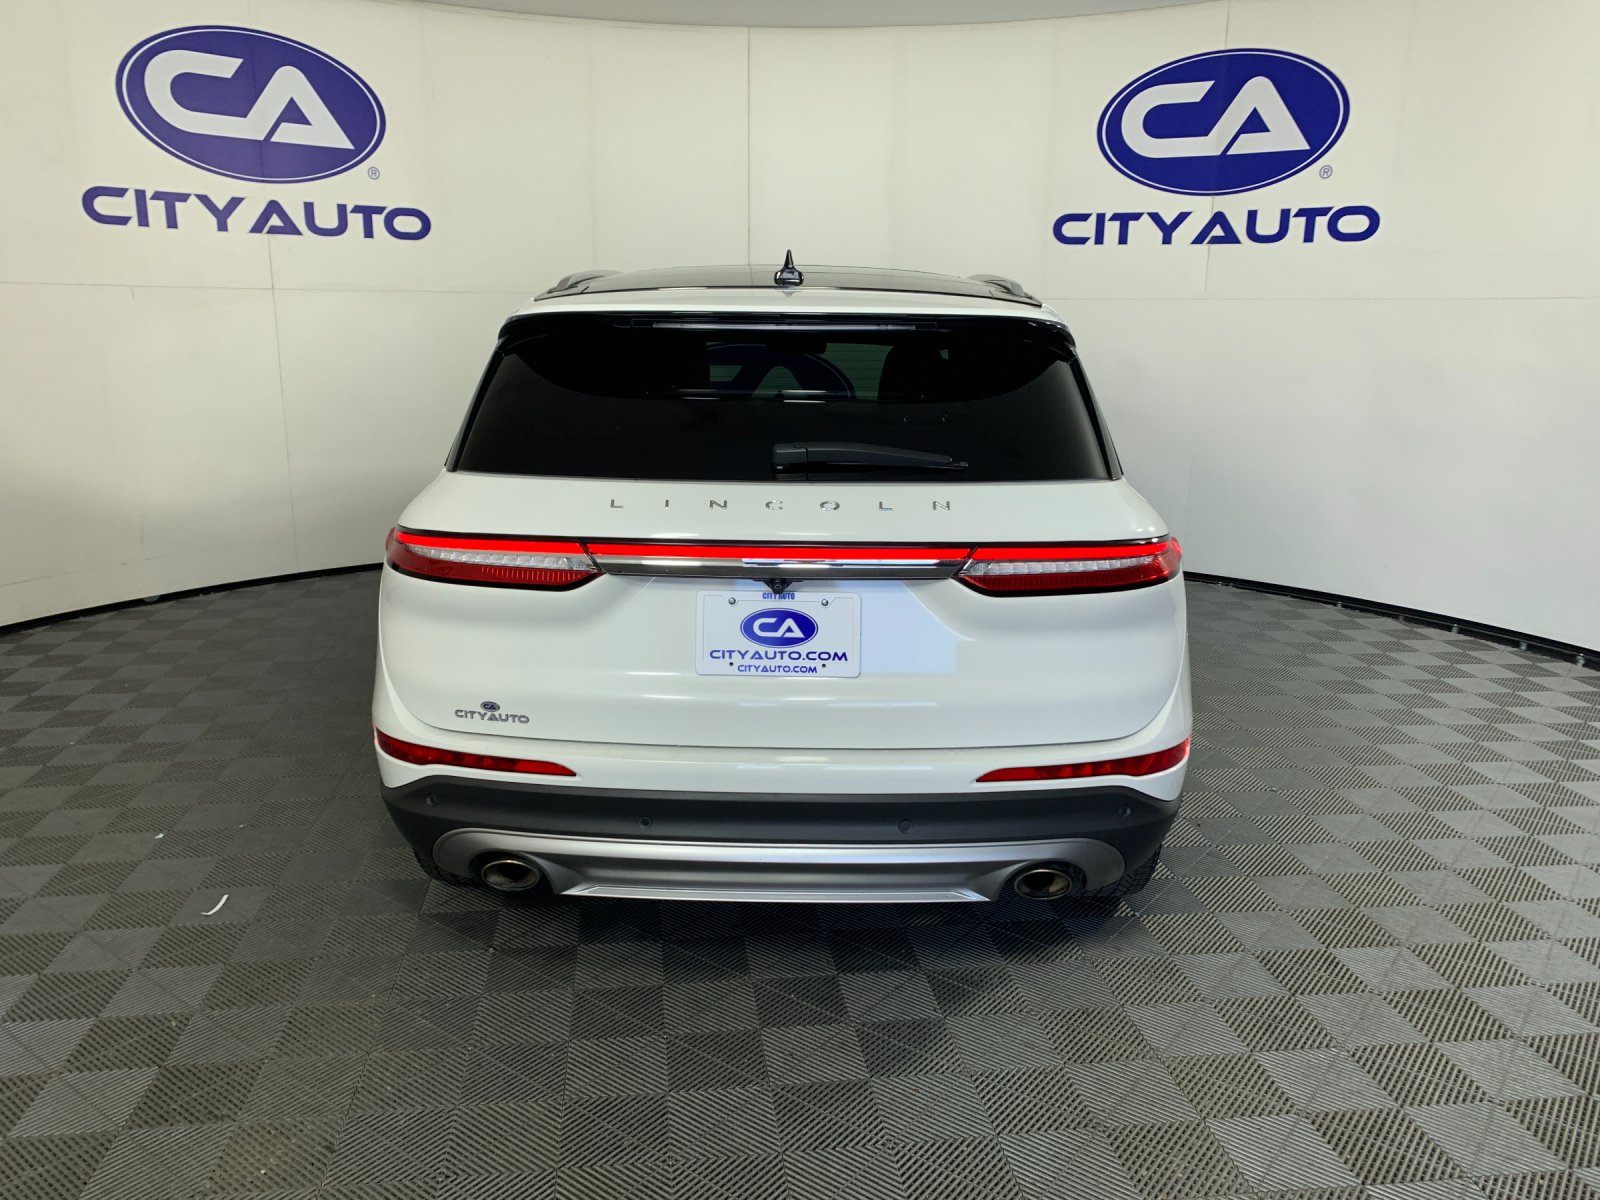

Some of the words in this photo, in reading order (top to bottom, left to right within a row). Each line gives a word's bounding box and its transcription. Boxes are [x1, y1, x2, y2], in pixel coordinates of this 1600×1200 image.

[143, 49, 355, 150] CA
[1121, 75, 1311, 158] CA
[609, 498, 951, 511] LINCOLN
[753, 617, 805, 638] CA
[709, 649, 848, 661] CITYAUTO.COM
[737, 664, 818, 674] CITYAUTO.COM
